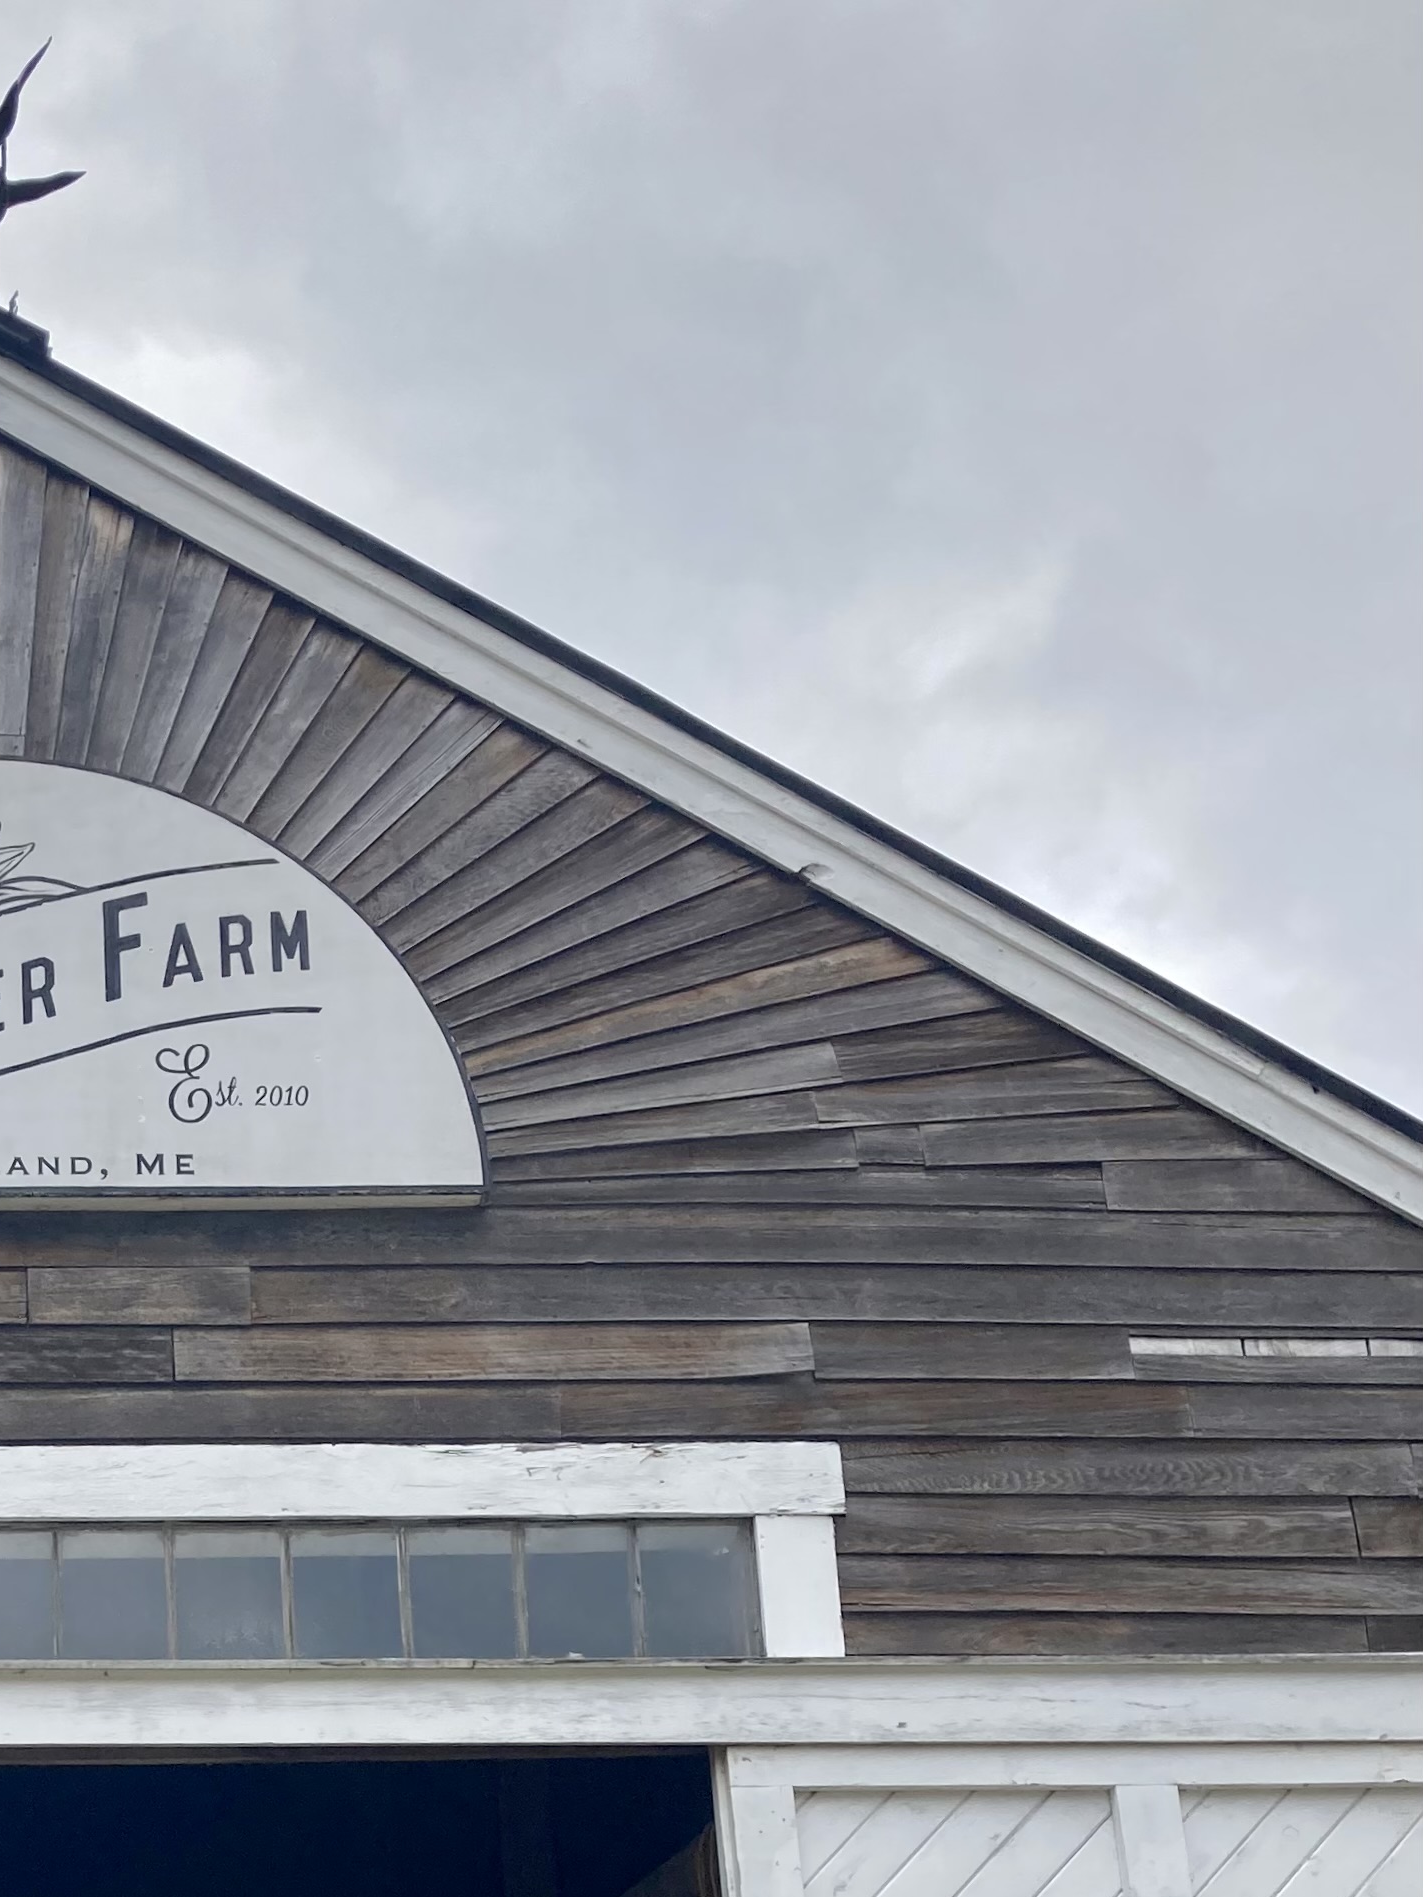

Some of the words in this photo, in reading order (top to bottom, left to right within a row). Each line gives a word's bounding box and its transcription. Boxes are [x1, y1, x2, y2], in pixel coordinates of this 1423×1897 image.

[103, 891, 312, 1003] FARM
[155, 1043, 243, 1124] Est.
[254, 1084, 309, 1107] 2010
[136, 1152, 196, 1176] ME
